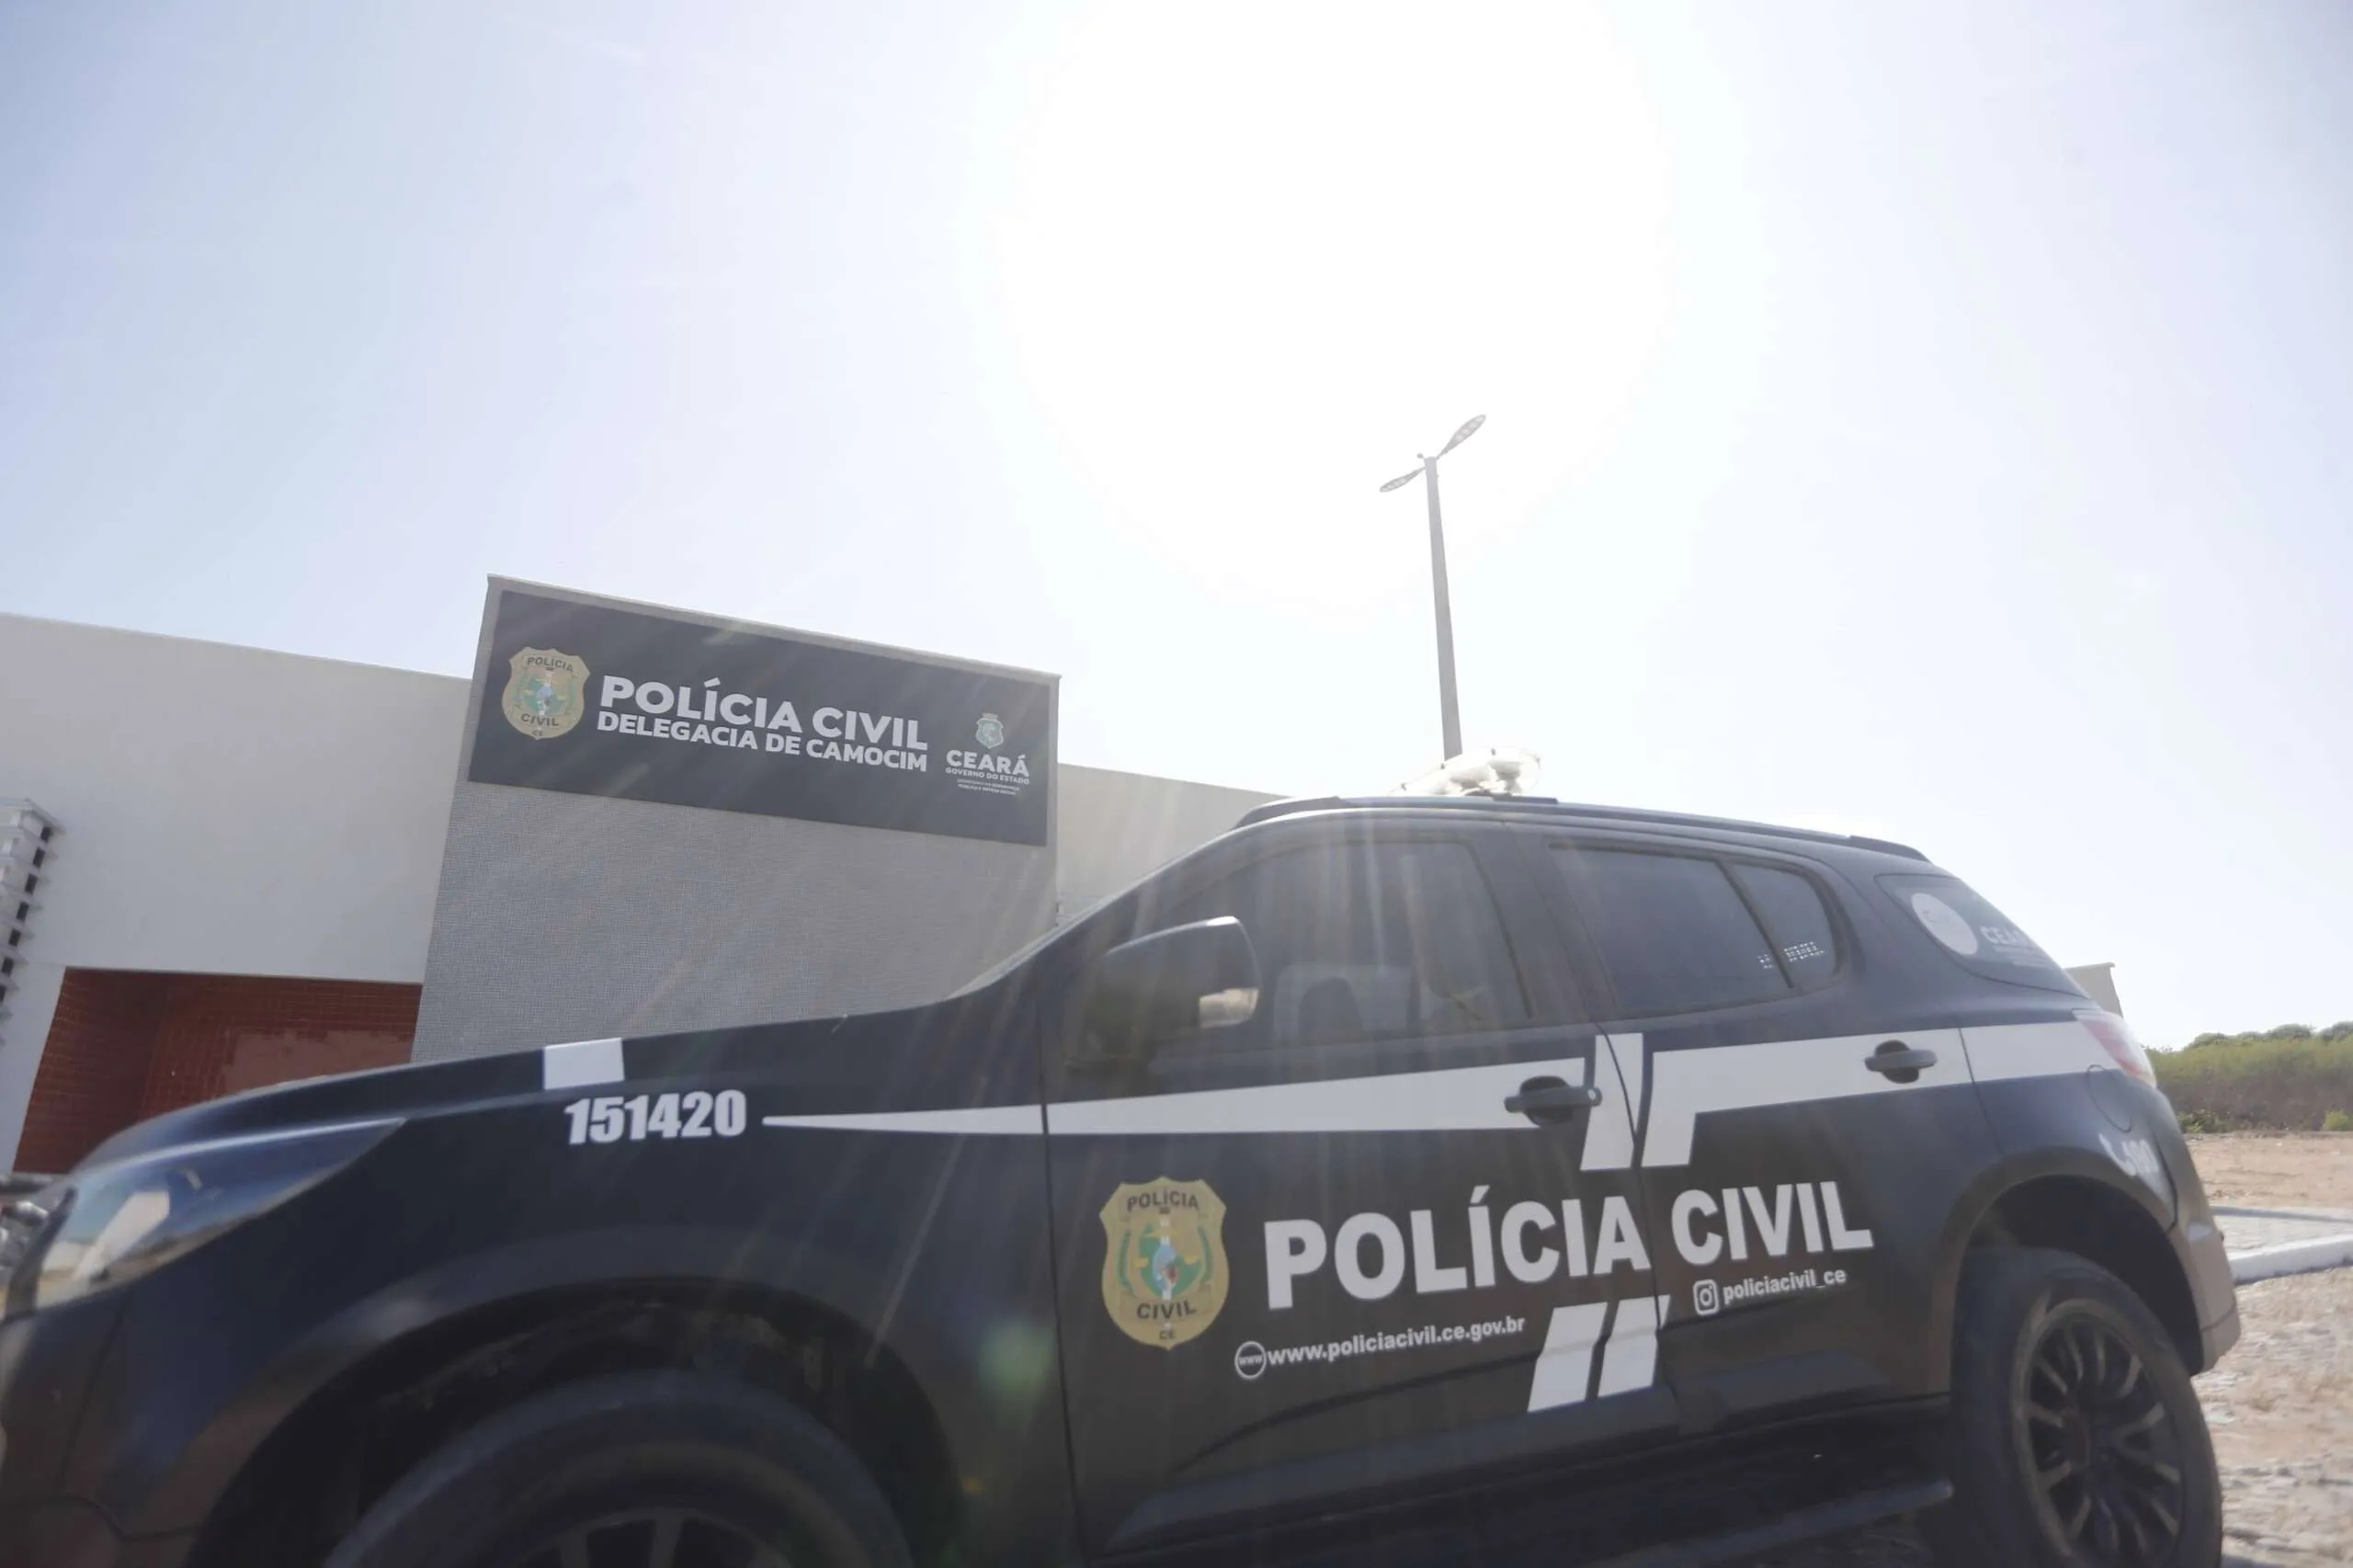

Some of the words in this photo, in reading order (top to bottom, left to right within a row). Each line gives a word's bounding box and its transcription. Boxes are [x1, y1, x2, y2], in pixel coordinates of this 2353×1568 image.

[521, 713, 560, 726] CIVIL
[600, 674, 803, 733] POLÍCIA
[812, 707, 928, 751] CIVIL
[597, 710, 758, 750] DELEGACIA
[766, 733, 801, 756] DE
[806, 739, 927, 772] CAMOCIM
[945, 767, 985, 779] GOVERNO
[999, 774, 1030, 786] ESTADO
[946, 749, 1030, 778] CEARÁ
[564, 1089, 747, 1145] 151420
[1265, 1185, 1652, 1310] POLÍCIA
[1671, 1181, 1875, 1267] CIVIL
[1722, 1268, 1847, 1306] policiacivil_ce
[1136, 1301, 1198, 1320] CIVIL
[1267, 1315, 1526, 1366] www.policiacivil.ce.gov.br
